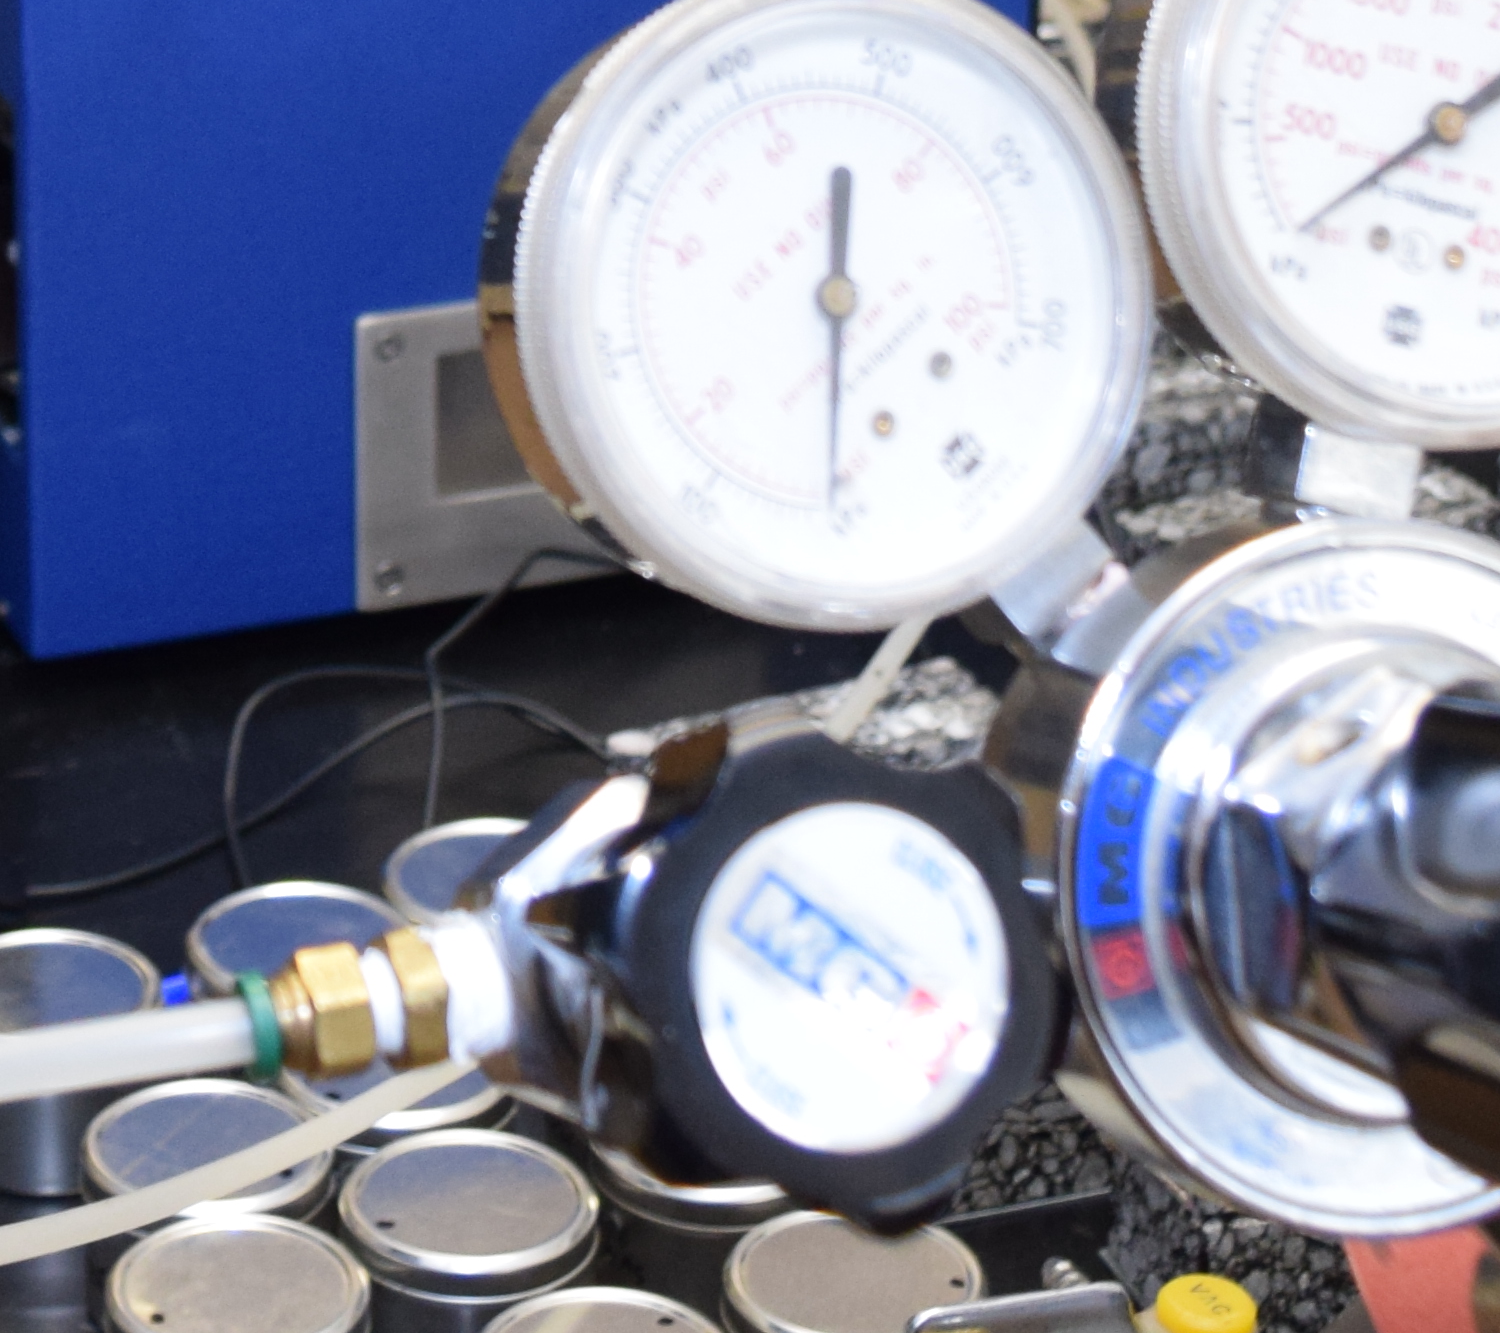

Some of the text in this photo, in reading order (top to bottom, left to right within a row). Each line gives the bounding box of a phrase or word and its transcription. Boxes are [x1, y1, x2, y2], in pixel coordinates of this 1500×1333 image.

[704, 43, 754, 86] 400
[859, 36, 911, 77] 500
[1301, 42, 1368, 81] 1000
[1283, 105, 1337, 141] 500
[761, 129, 797, 169] 60
[992, 133, 1036, 189] 600
[892, 157, 927, 193] 80
[674, 233, 706, 270] 40
[943, 293, 983, 336] 100
[700, 376, 736, 414] 20
[1140, 570, 1378, 737] INDUSTRIES
